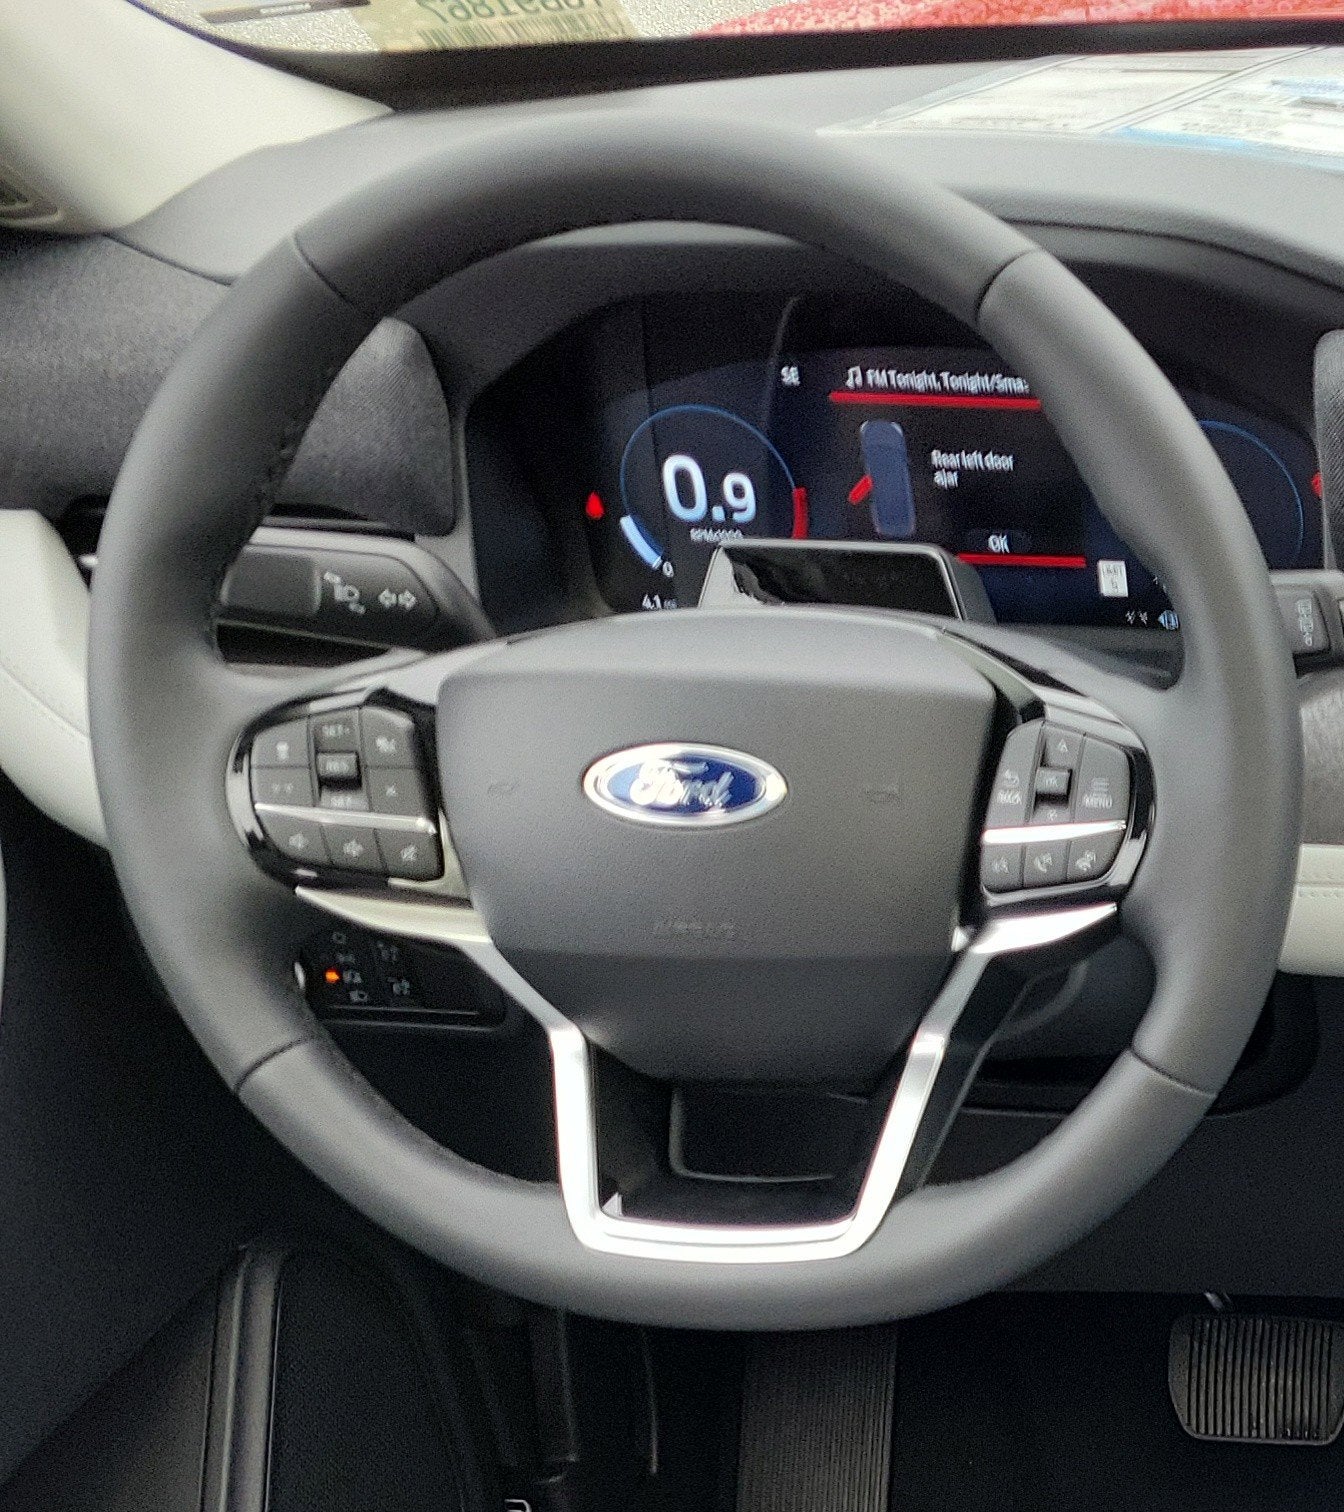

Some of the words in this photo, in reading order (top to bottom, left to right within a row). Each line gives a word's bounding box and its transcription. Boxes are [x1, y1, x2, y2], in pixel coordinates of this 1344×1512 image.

[866, 367, 888, 389] FM
[930, 449, 961, 470] Rear
[984, 450, 1015, 473] door
[662, 454, 757, 524] 0.9
[933, 471, 959, 490] ajar
[987, 534, 1010, 555] OK
[1083, 794, 1113, 810] MENU
